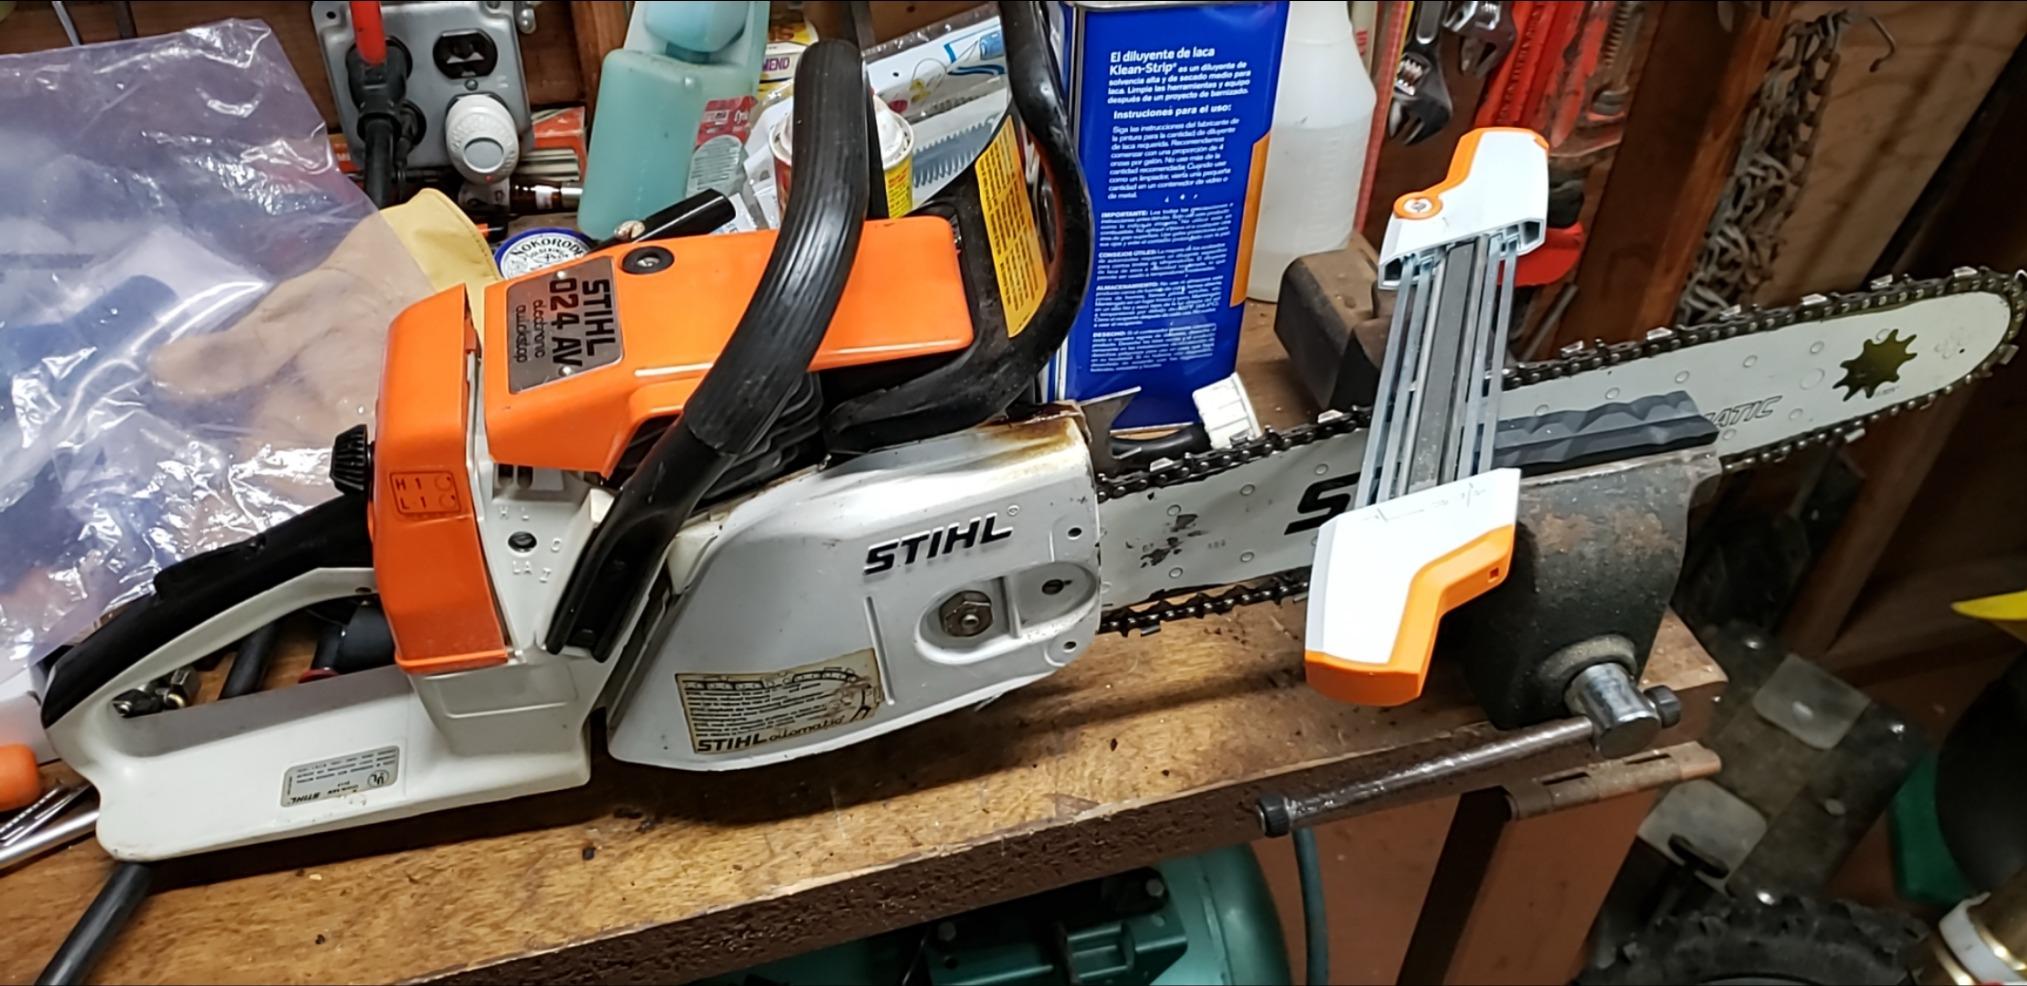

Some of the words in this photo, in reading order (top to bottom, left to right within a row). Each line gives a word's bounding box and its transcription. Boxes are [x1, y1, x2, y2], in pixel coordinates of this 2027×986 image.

[1111, 51, 1121, 63] El
[1122, 49, 1175, 64] diluyente
[1177, 46, 1191, 59] de
[1193, 46, 1215, 58] laca
[1201, 62, 1236, 72] diluyente
[1237, 61, 1247, 69] de
[1175, 106, 1197, 117] para
[1199, 103, 1209, 114] el
[1211, 103, 1232, 113] uso:
[549, 277, 580, 330] 024
[581, 278, 616, 357] STIHL
[552, 336, 583, 367] AV
[863, 511, 1014, 576] STIHL
[697, 733, 767, 751] STIHL
